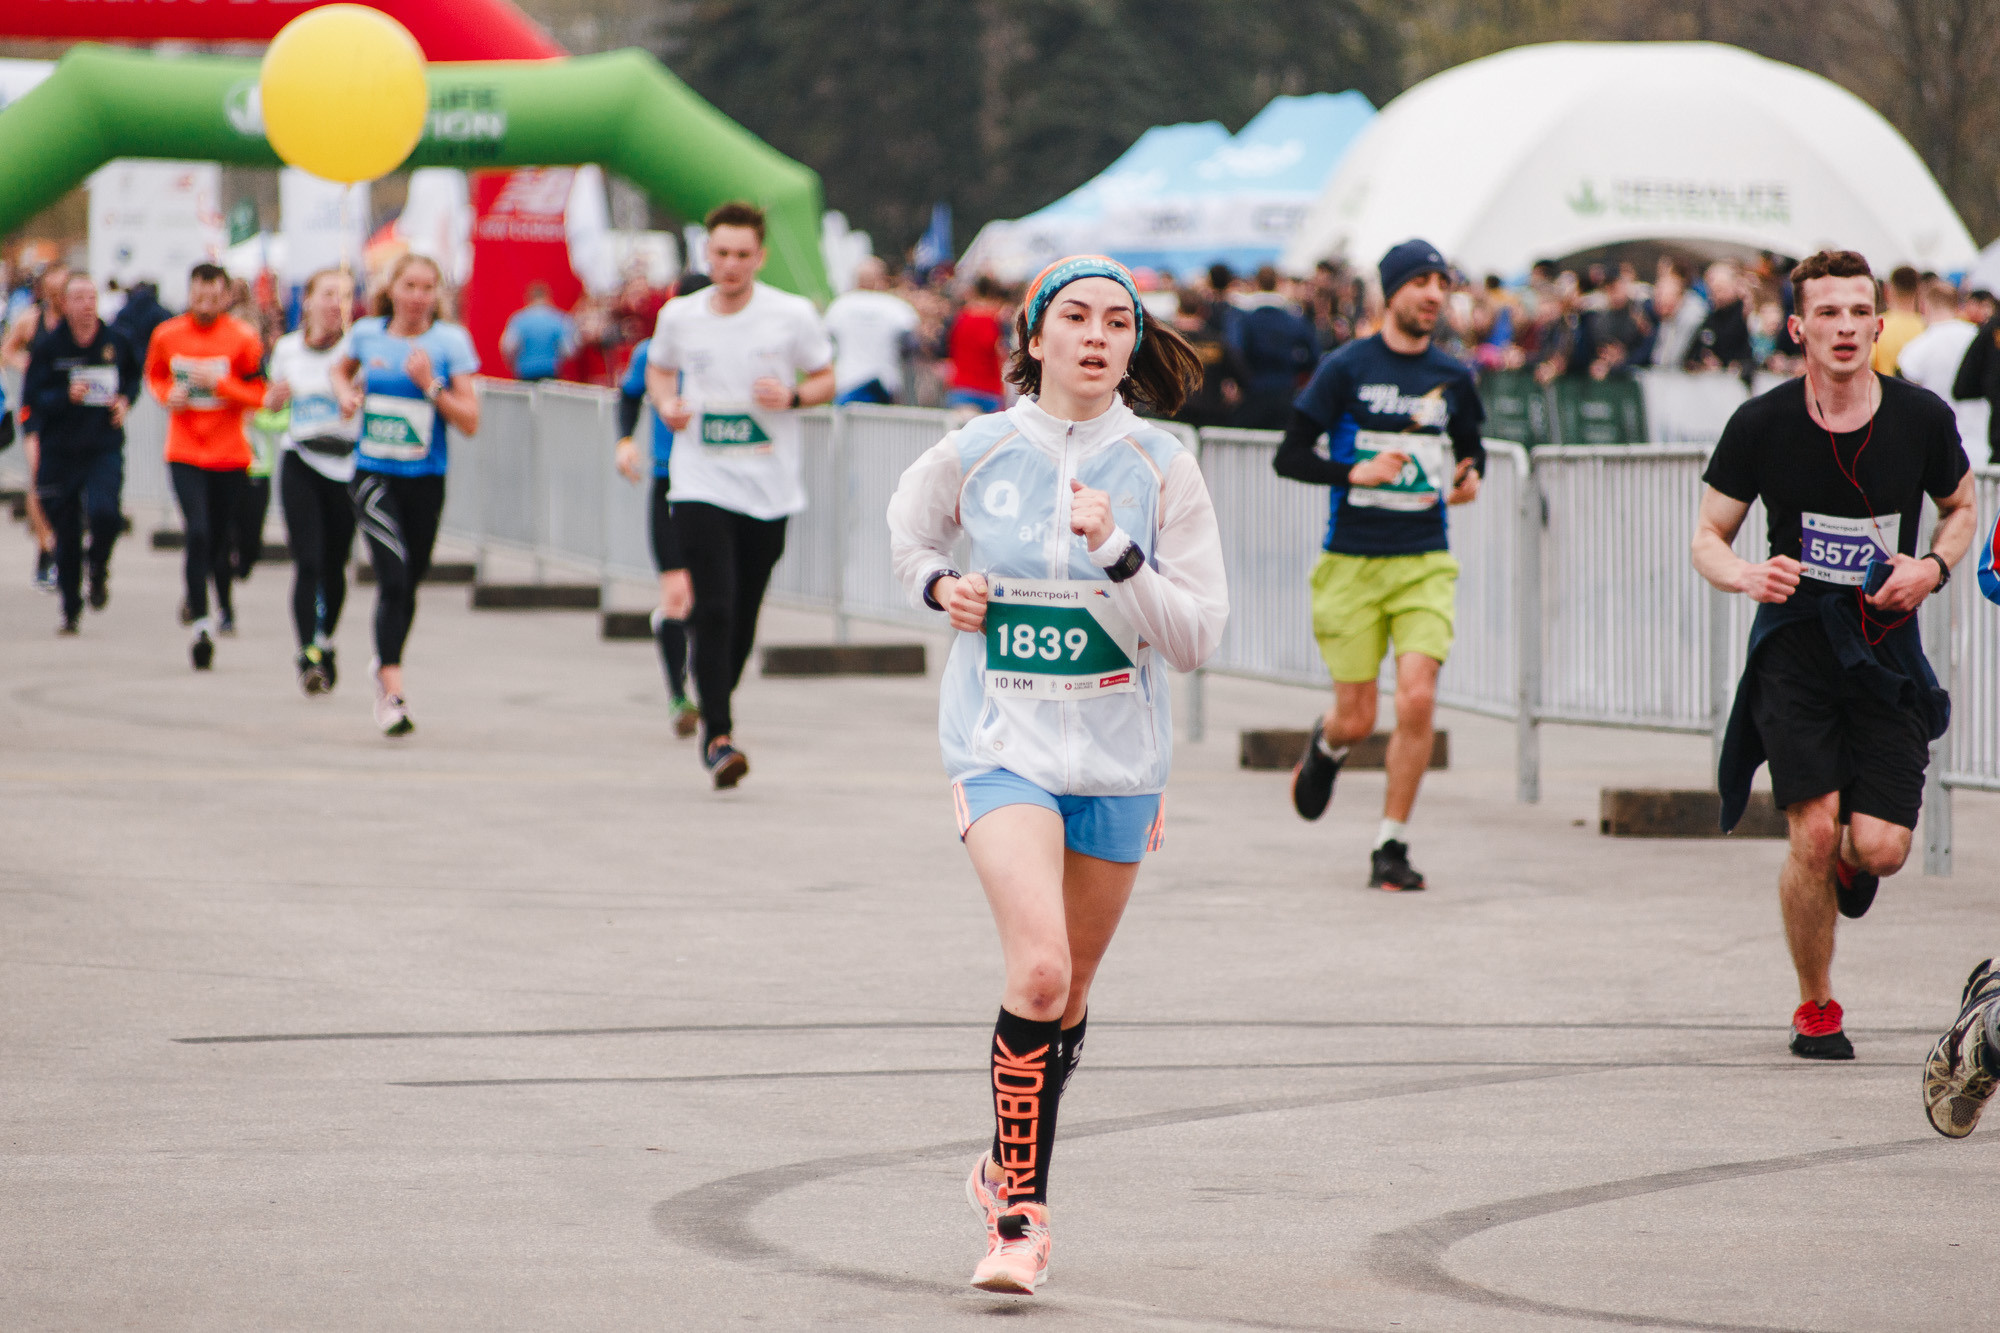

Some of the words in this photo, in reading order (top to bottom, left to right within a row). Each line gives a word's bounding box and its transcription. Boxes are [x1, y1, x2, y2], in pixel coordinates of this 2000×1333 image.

[1810, 538, 1876, 567] 5572
[1011, 588, 1079, 600] Жилстрой-1
[997, 623, 1088, 661] 1839
[995, 677, 1008, 689] 10
[993, 1033, 1050, 1196] REEBOK
